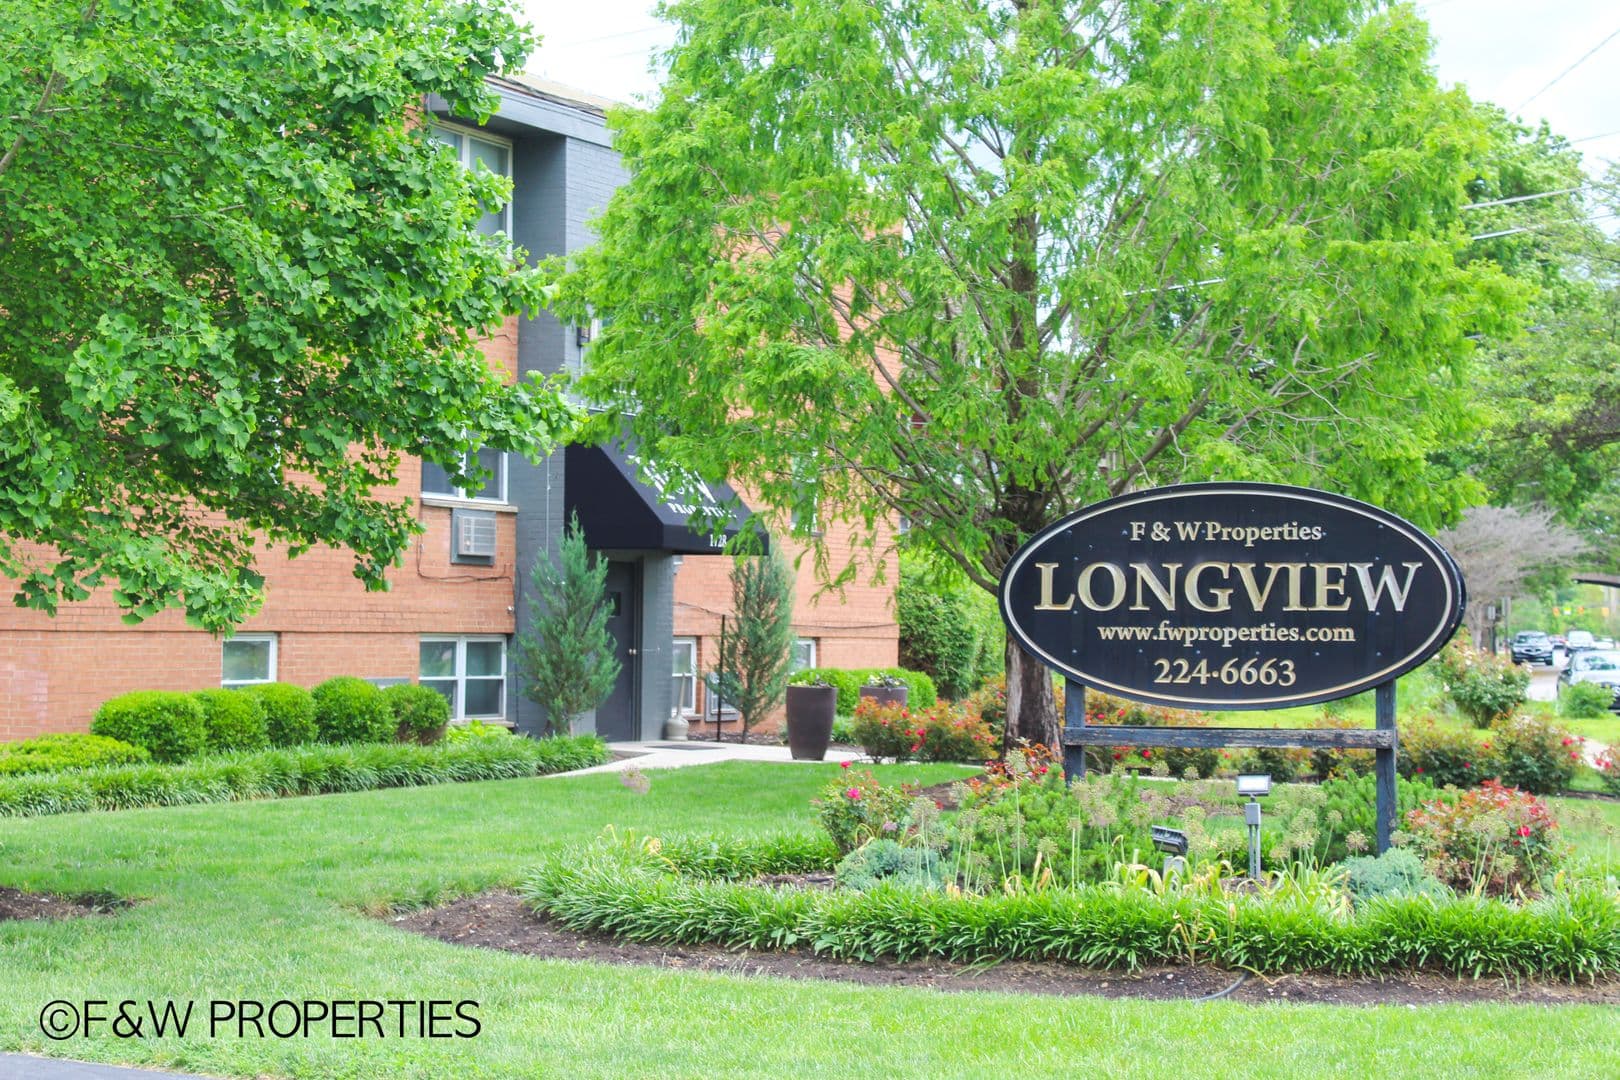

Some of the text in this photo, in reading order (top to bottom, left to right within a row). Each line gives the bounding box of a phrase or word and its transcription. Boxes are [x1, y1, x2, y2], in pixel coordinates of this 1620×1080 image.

[1130, 521, 1322, 547] F & W Properties
[1033, 561, 1423, 612] LONGVIEW
[1097, 620, 1356, 647] www.fwproperties.com
